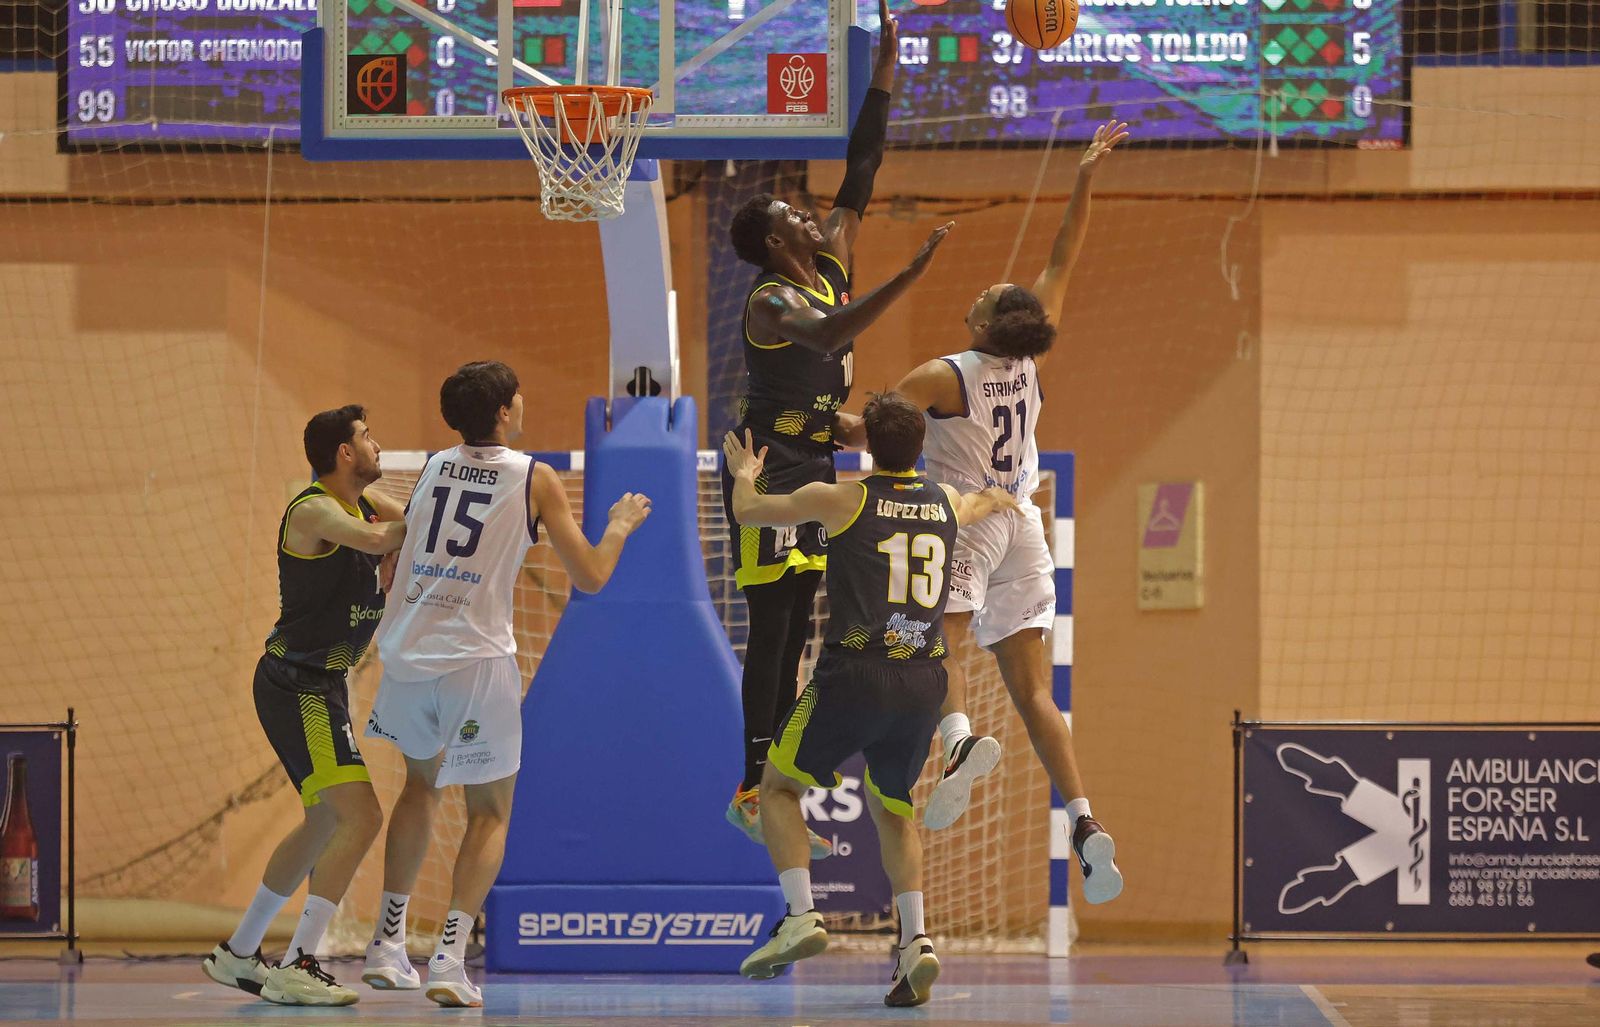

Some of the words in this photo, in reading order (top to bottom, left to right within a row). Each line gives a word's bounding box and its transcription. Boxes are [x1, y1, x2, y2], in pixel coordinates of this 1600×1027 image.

[79, 35, 115, 67] 55
[125, 39, 194, 62] VICTOR
[1148, 33, 1247, 62] TOLEDO
[1352, 31, 1371, 66] 5
[78, 89, 116, 122] 99
[785, 104, 808, 113] FEB
[990, 84, 1028, 119] 98
[1353, 85, 1372, 118] 0
[841, 352, 853, 387] 10
[991, 398, 1027, 473] 21
[439, 461, 498, 486] FLORES
[425, 487, 493, 558] 15
[876, 499, 918, 520] LOPEZ
[877, 532, 947, 609] 13
[1448, 787, 1558, 813] FOR-SER
[1448, 812, 1549, 842] ESPAÑA
[1554, 816, 1590, 842] S.L
[1497, 880, 1514, 893] 97
